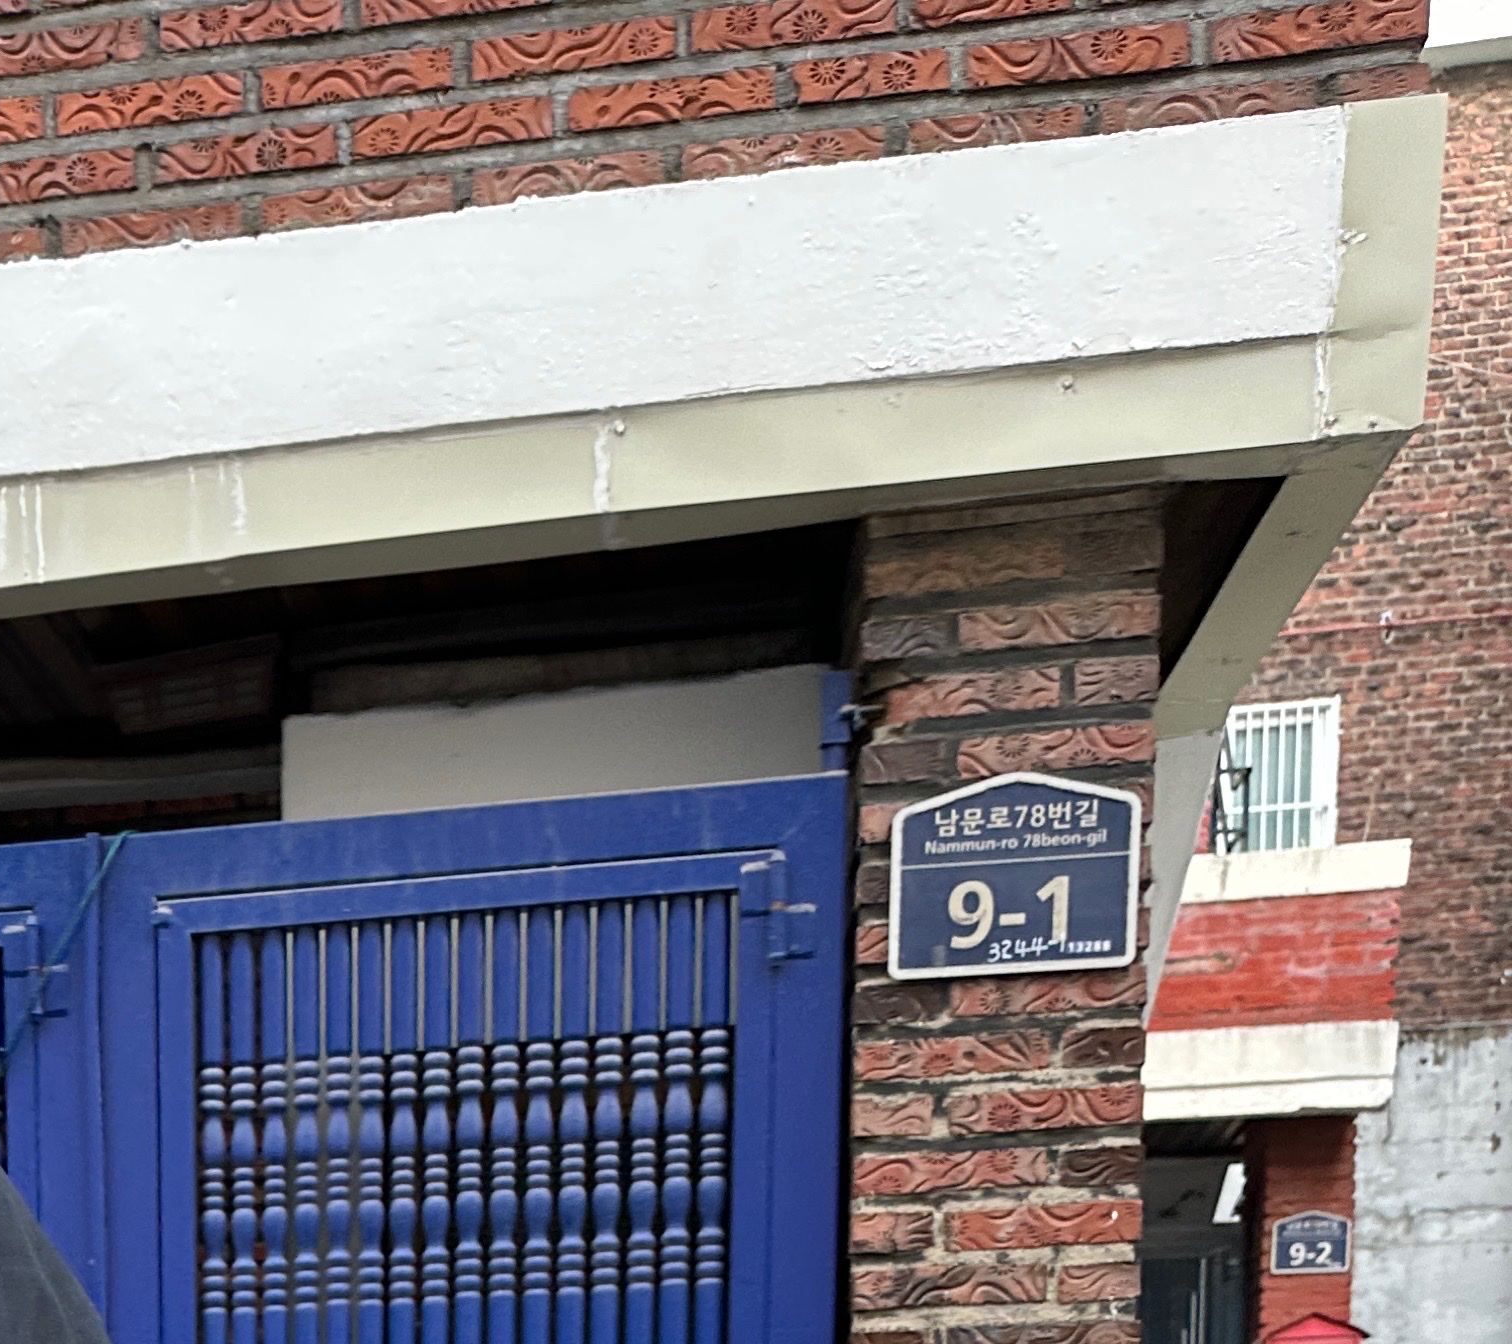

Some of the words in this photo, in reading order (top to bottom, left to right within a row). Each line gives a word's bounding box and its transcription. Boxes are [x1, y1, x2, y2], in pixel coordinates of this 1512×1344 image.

[934, 798, 1099, 838] 남문로78번길
[924, 837, 1019, 855] Nammun-ro
[1023, 829, 1108, 847] 78beon-gil
[947, 875, 1070, 950] 9-1
[1289, 1241, 1332, 1267] 9-2
